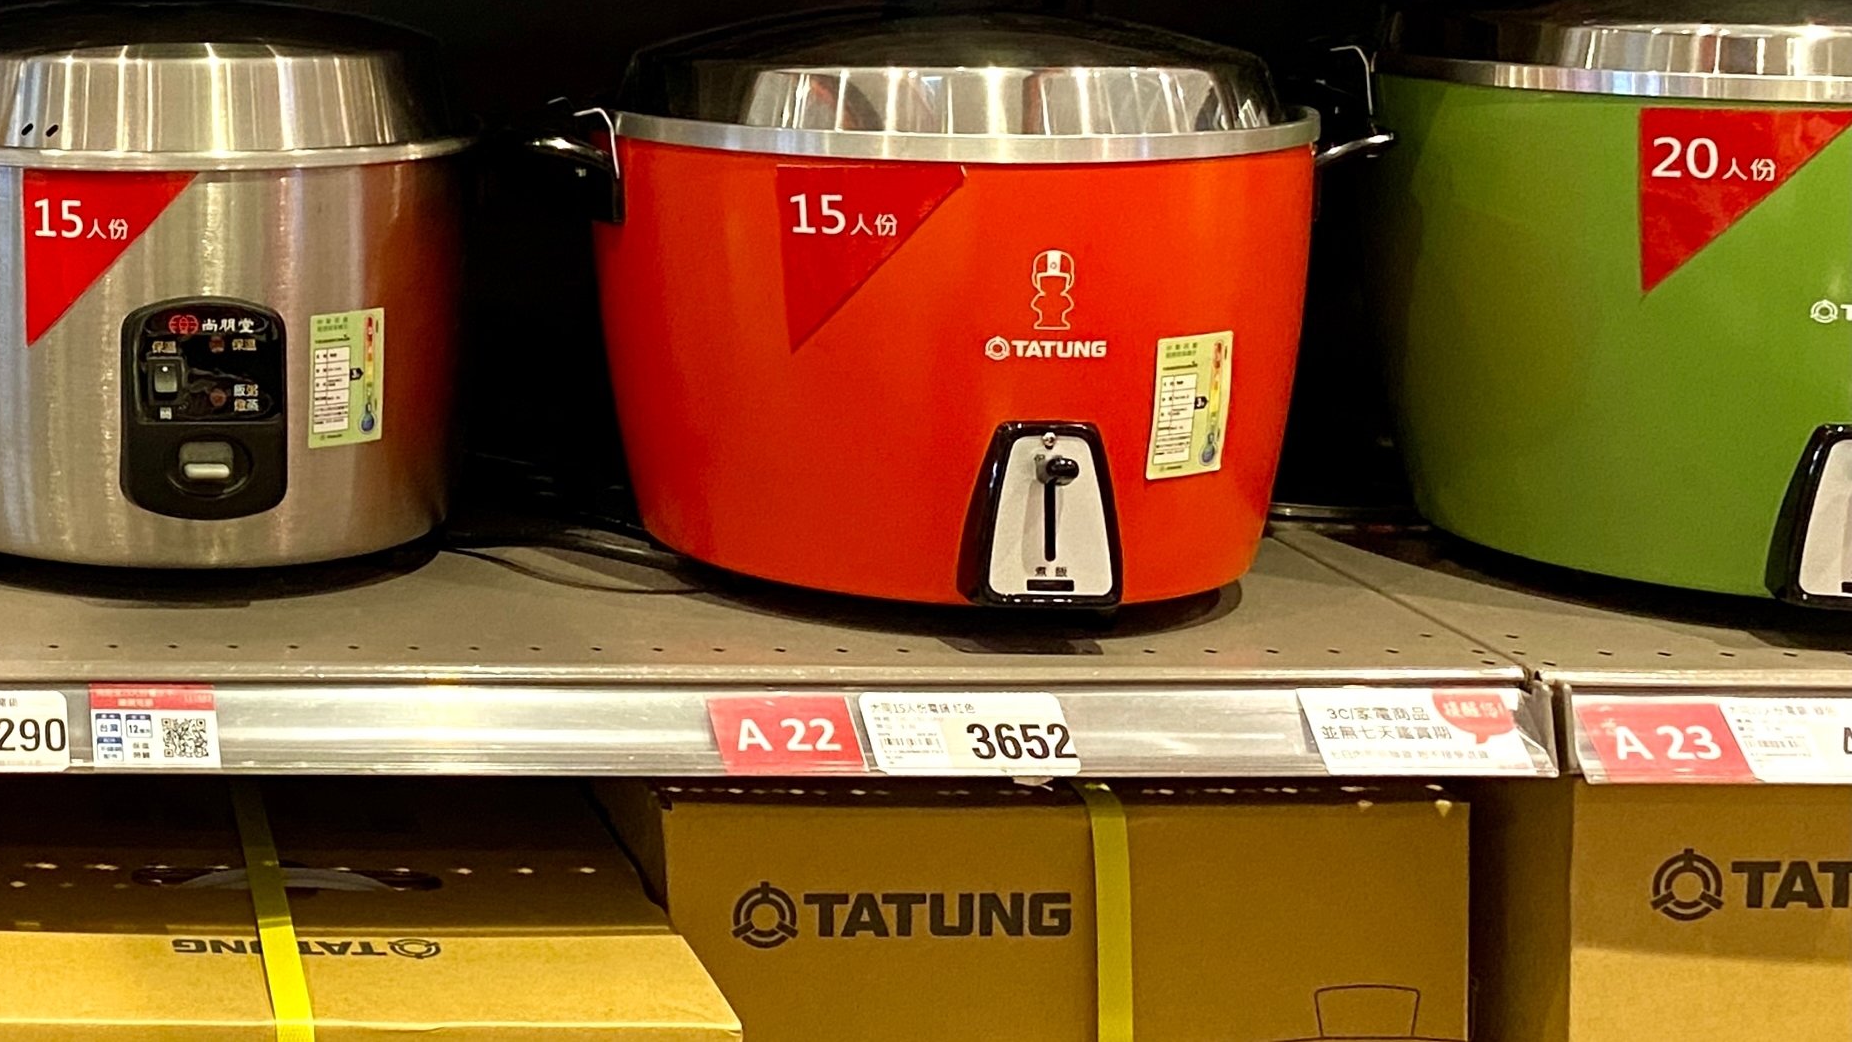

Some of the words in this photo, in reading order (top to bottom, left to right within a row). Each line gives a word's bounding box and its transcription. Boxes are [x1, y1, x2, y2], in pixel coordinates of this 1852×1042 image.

[1651, 138, 1776, 181] 20人份
[34, 199, 128, 240] 15人份
[789, 193, 898, 237] 15人份
[202, 318, 254, 333] 尚朋堂
[1012, 340, 1107, 358] TATUNG
[1328, 707, 1431, 720] 3C/家電商品
[737, 718, 773, 751] A
[780, 718, 842, 751] 22
[966, 723, 1078, 759] 3652
[1322, 726, 1452, 740] 並無七天鑑賞期
[1615, 725, 1654, 760] A
[1656, 725, 1722, 760] 23
[1731, 860, 1852, 908] TAT
[803, 892, 1072, 937] TATUNG
[172, 938, 388, 956] TATNG
